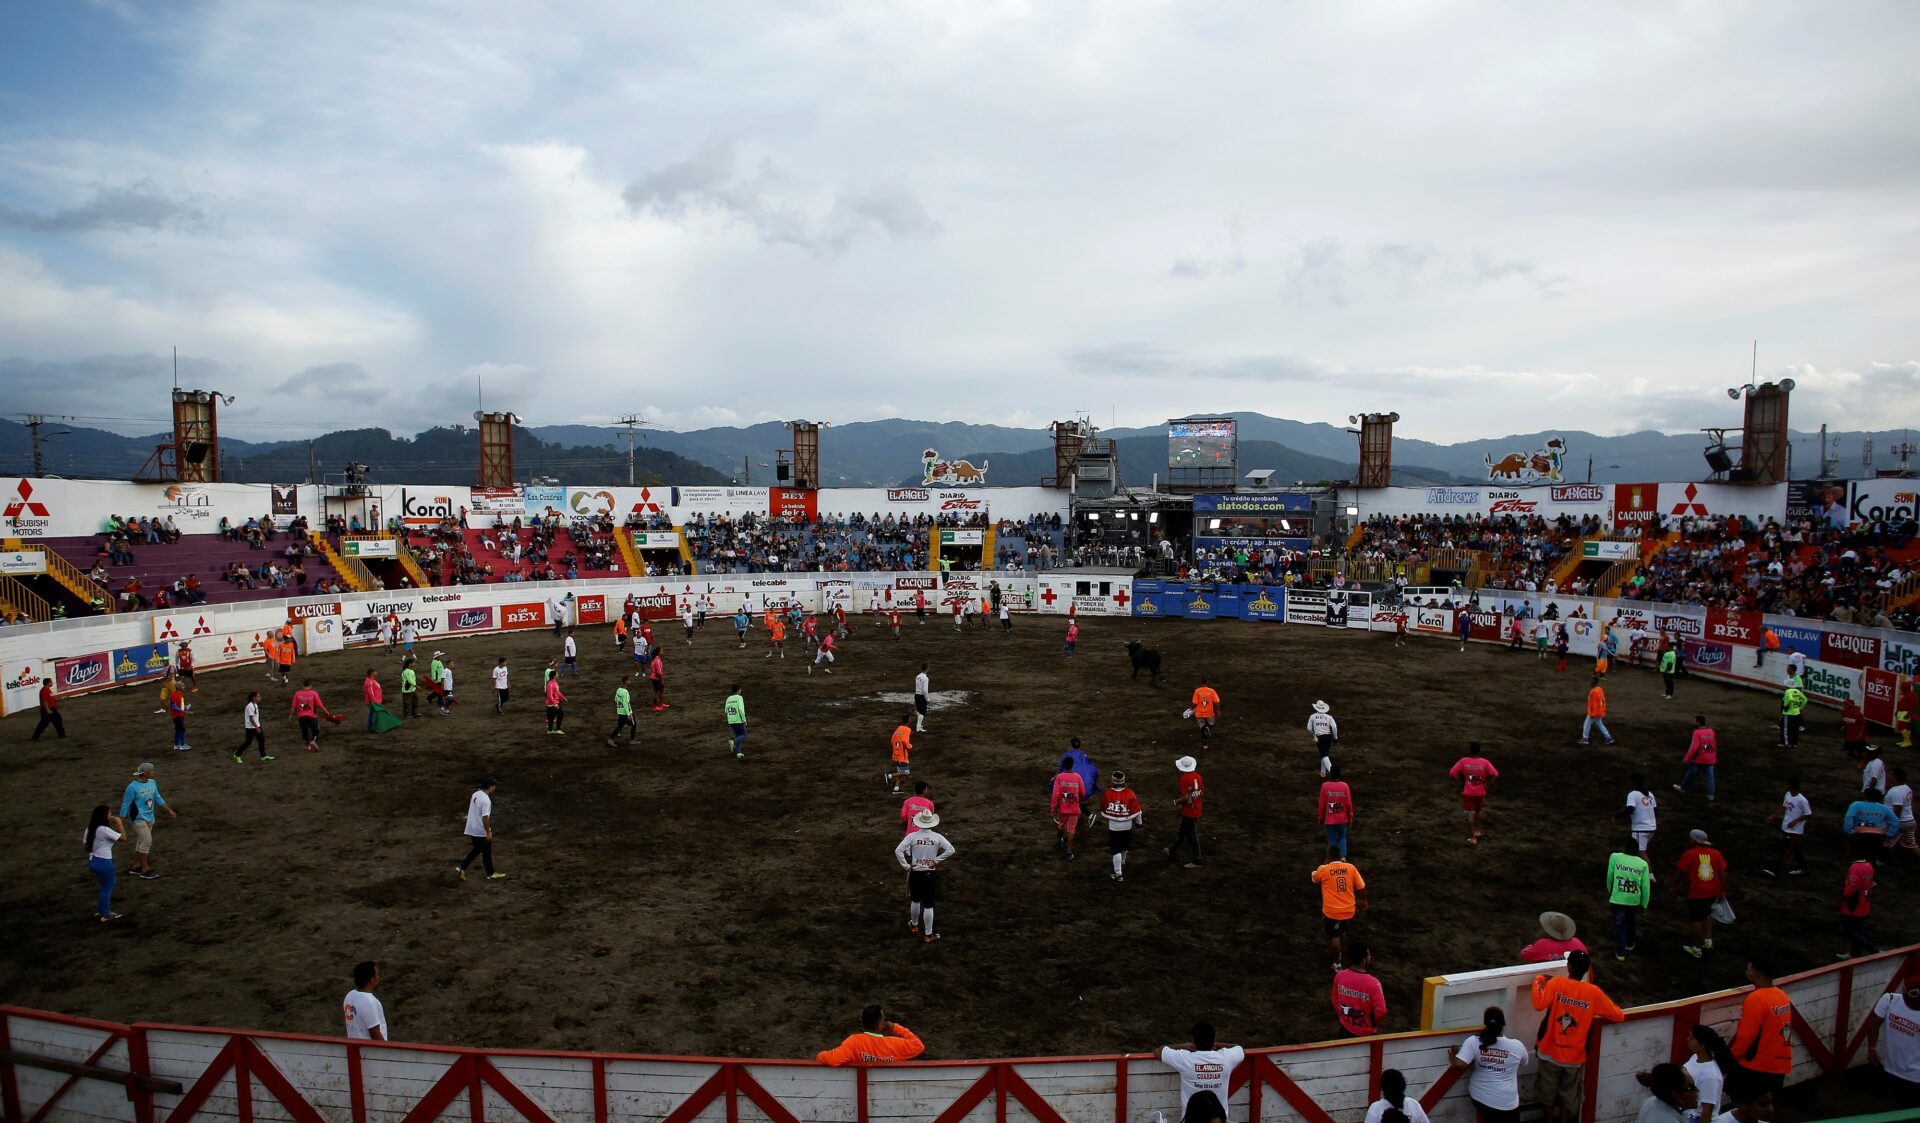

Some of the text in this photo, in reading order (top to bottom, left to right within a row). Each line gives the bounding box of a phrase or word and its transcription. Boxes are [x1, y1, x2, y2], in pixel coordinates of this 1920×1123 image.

[889, 491, 898, 500] EL
[1428, 488, 1479, 504] Andrews
[1488, 491, 1519, 499] DIARIO
[1553, 487, 1601, 501] EL ANGEL
[1894, 494, 1914, 503] SUR
[402, 488, 452, 516] Koral
[1216, 502, 1285, 511] siatodos.com
[1489, 499, 1538, 513] Extra
[1850, 482, 1920, 522] Koral
[13, 528, 43, 536] MOTORS
[752, 579, 787, 587] telecable
[899, 578, 933, 588] CACIQUE
[422, 593, 461, 603] telecable
[635, 596, 672, 608] CACIQUE
[294, 603, 335, 618] CACIQUE
[367, 602, 413, 615] Vianney
[1249, 603, 1278, 611] GOLLO
[1379, 605, 1404, 613] DIARIO
[507, 612, 538, 623] REY
[1417, 606, 1444, 627] Koral
[1713, 624, 1750, 640] REY
[1774, 627, 1819, 642] LINEA LAW
[1827, 632, 1875, 655] CACIQUE
[6, 677, 41, 690] telecable
[1804, 665, 1851, 691] Palace
[1867, 682, 1892, 697] REY
[1616, 864, 1642, 877] Vianney
[1336, 876, 1347, 893] 8
